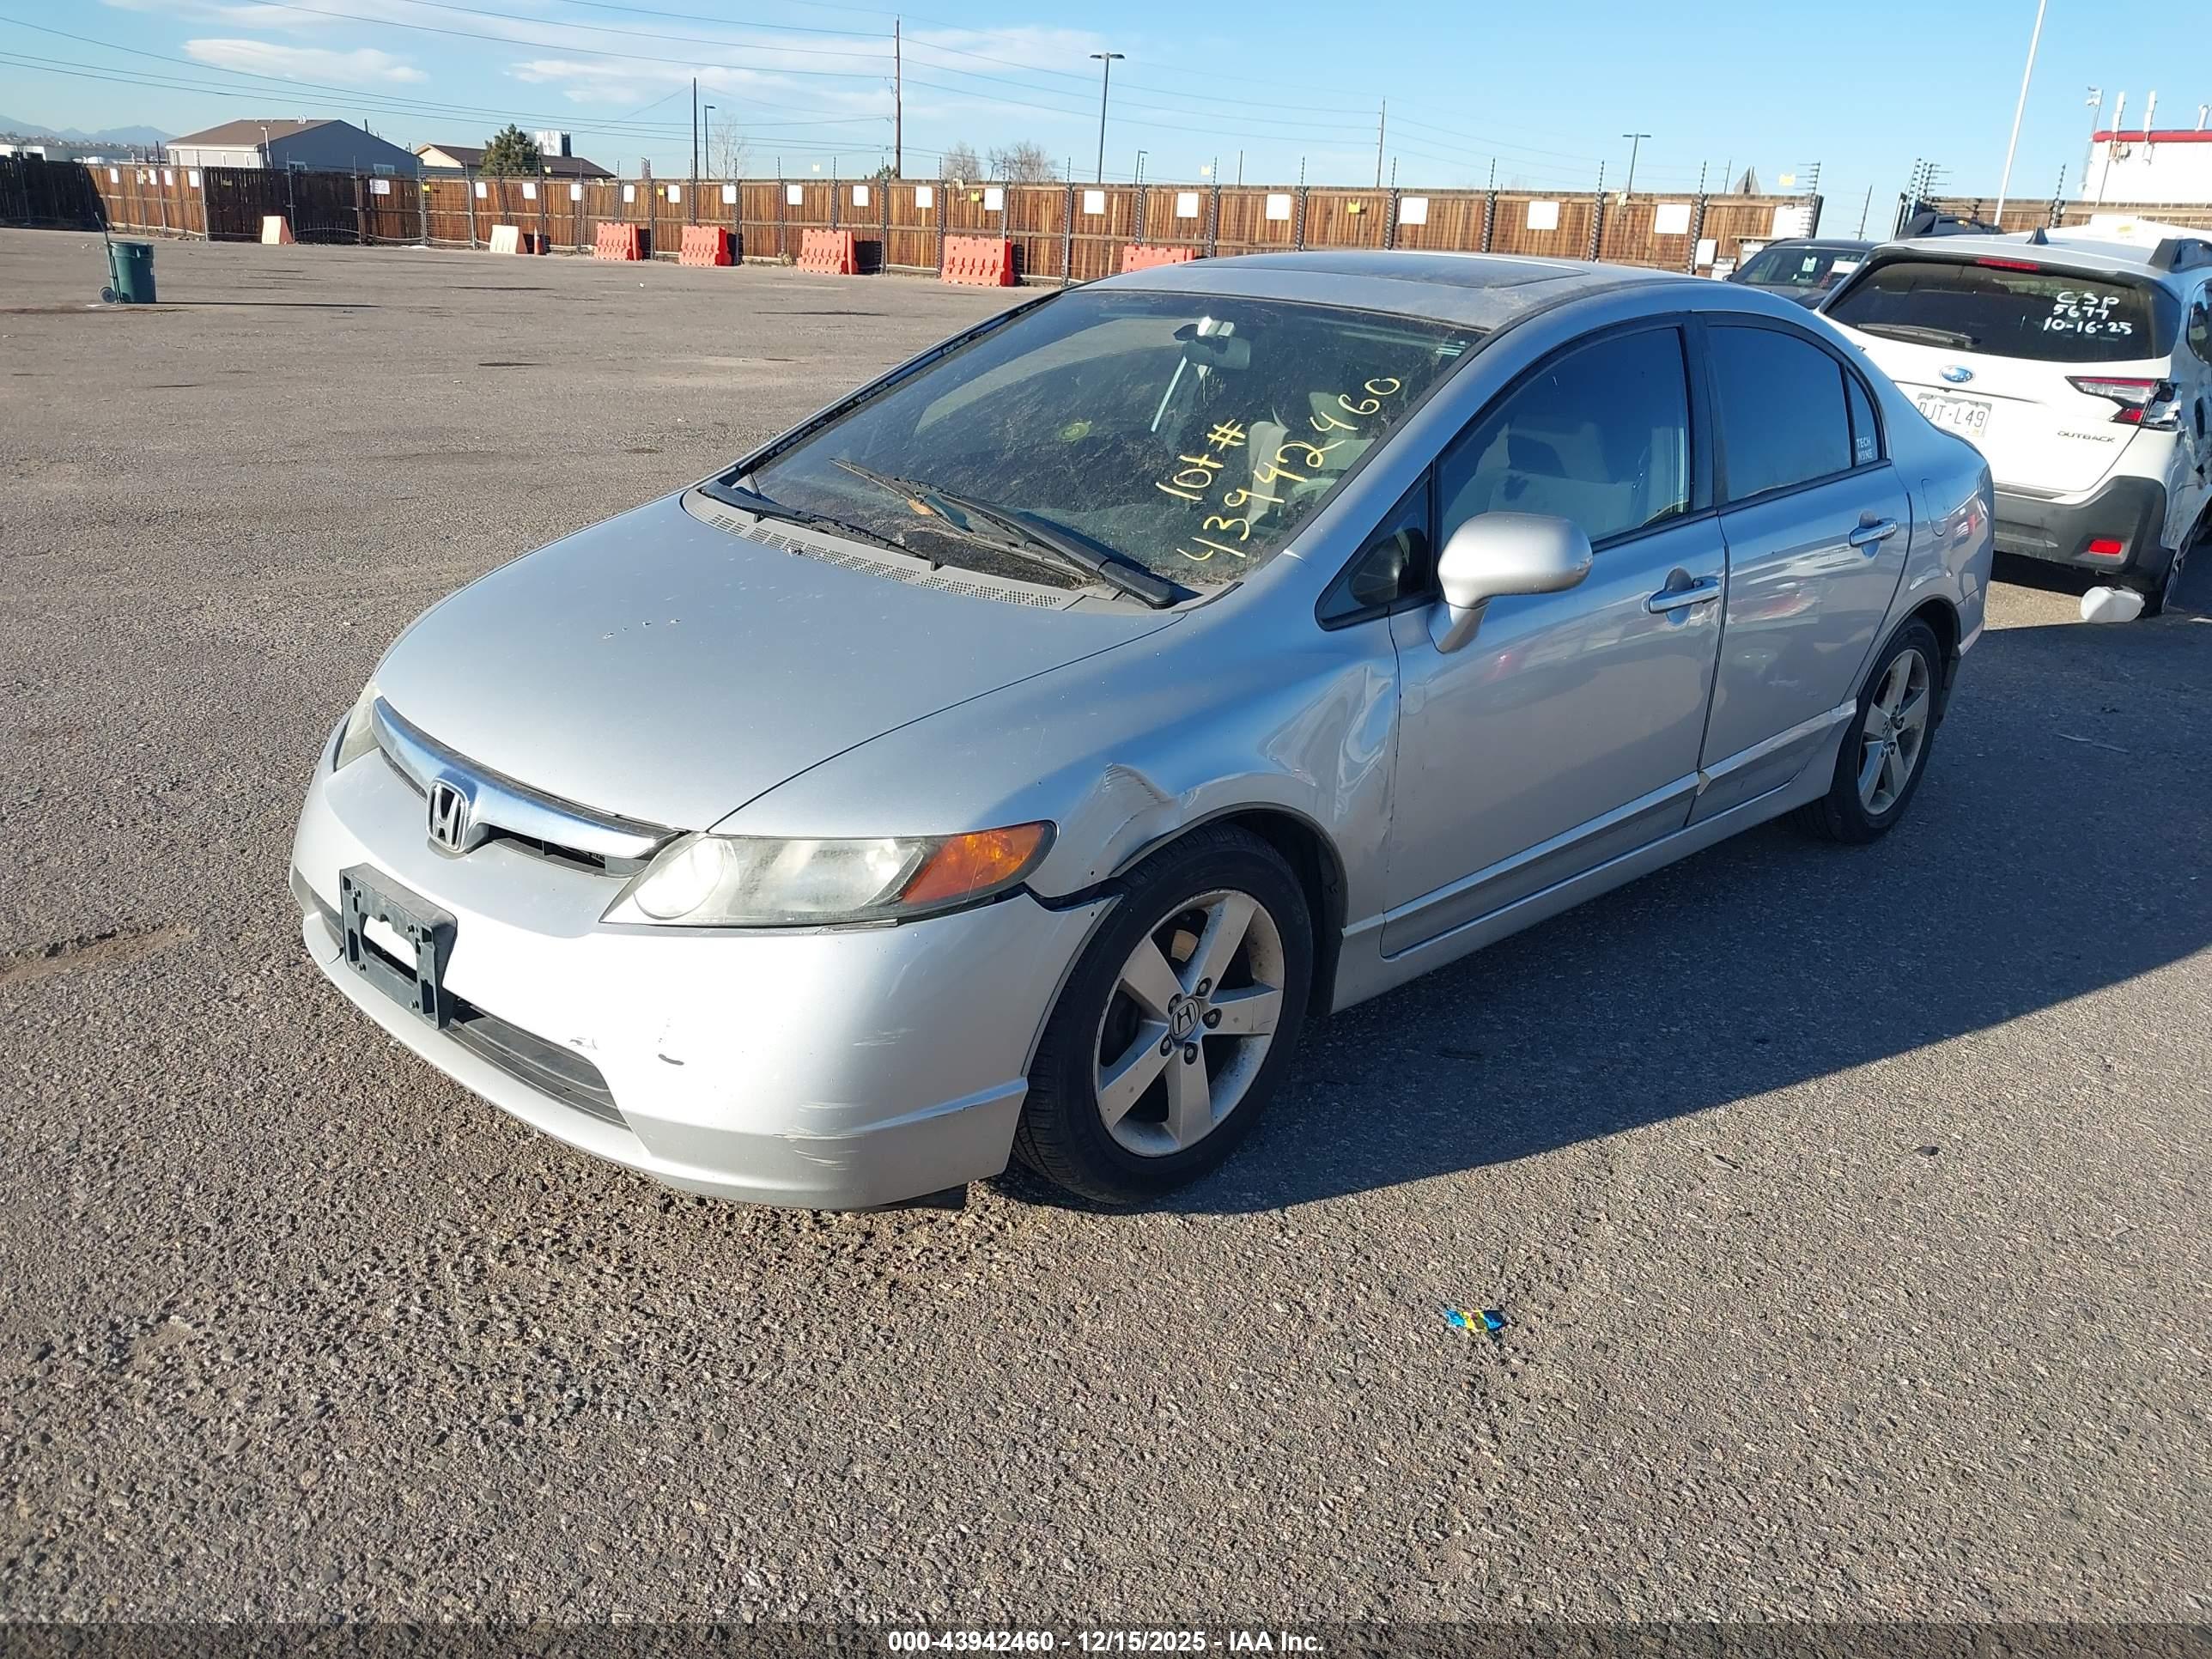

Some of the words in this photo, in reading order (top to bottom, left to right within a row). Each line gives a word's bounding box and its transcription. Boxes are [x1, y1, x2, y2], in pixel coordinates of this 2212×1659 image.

[2052, 303, 2110, 320] 5677
[2043, 316, 2133, 335] 10-16-25
[1206, 418, 1246, 453] #
[1856, 436, 1871, 448] TECH
[2057, 430, 2116, 443] OUTBACK
[1176, 377, 1401, 562] 43942460
